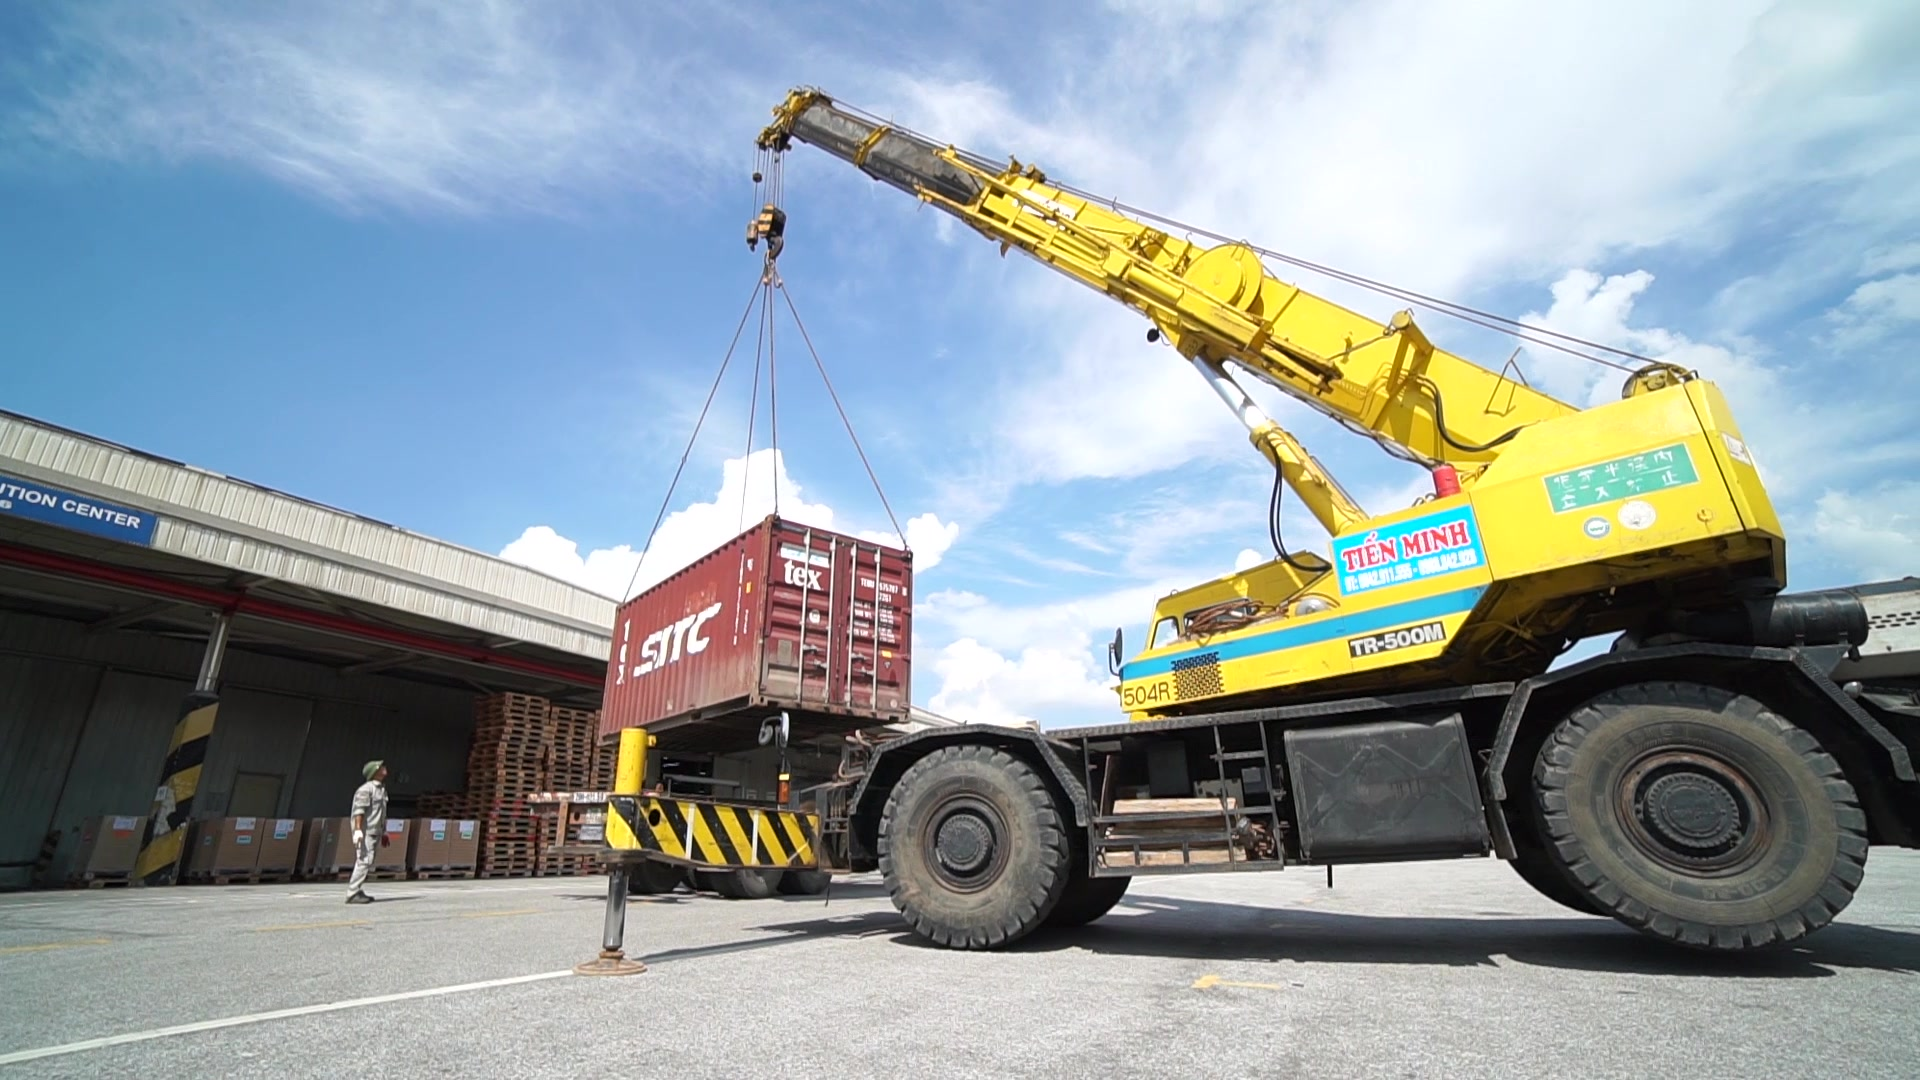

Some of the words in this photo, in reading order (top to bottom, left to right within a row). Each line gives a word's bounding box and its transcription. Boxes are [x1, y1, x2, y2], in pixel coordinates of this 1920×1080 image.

[62, 500, 140, 529] CENTER
[1342, 532, 1397, 571] TIẾN
[1402, 521, 1470, 558] MINH
[784, 559, 824, 591] tex
[633, 602, 722, 677] SITC
[1350, 623, 1443, 656] TR-500M
[1123, 682, 1171, 706] 504R
